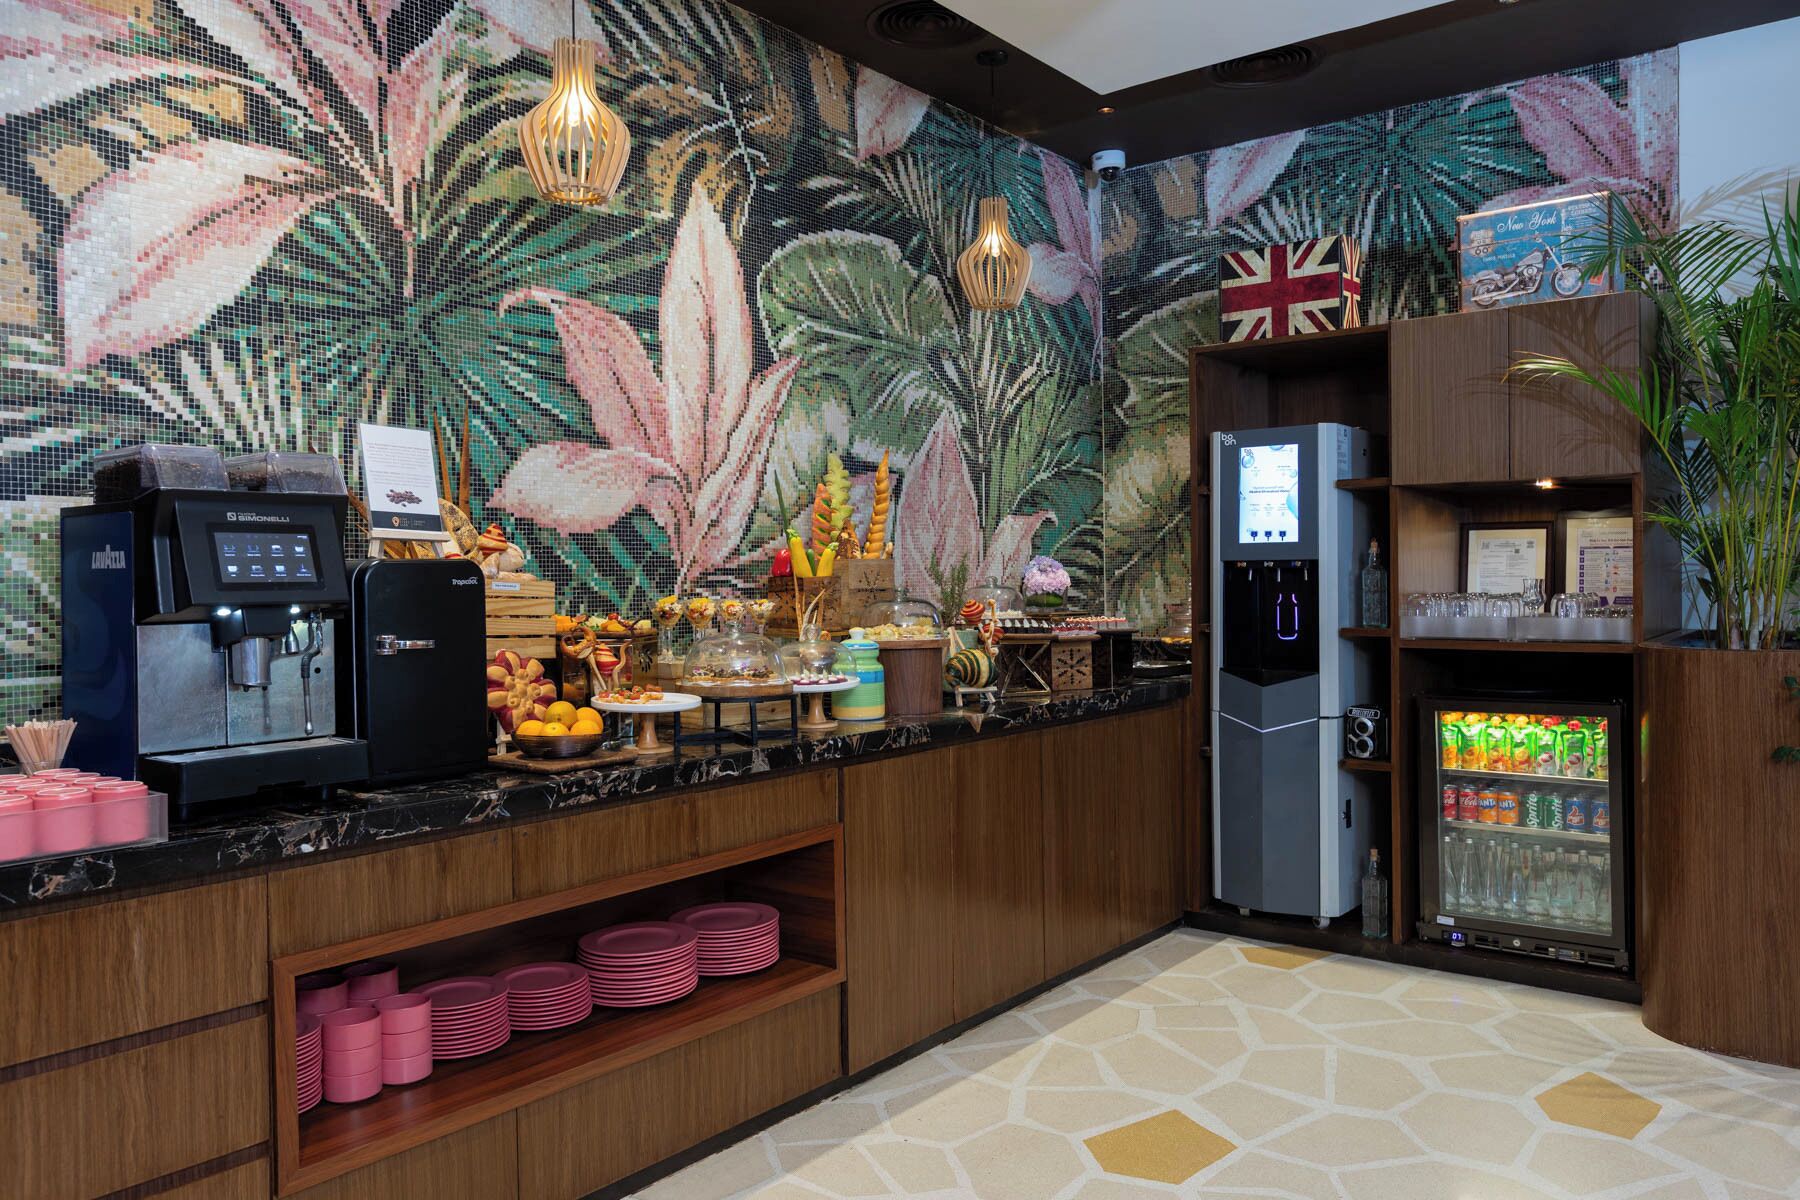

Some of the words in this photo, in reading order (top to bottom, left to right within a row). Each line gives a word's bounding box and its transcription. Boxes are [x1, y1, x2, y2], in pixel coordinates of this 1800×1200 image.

[1497, 215, 1524, 232] New
[1529, 211, 1556, 229] York
[91, 544, 126, 569] LAVAZZA
[1526, 793, 1540, 828] Sprite
